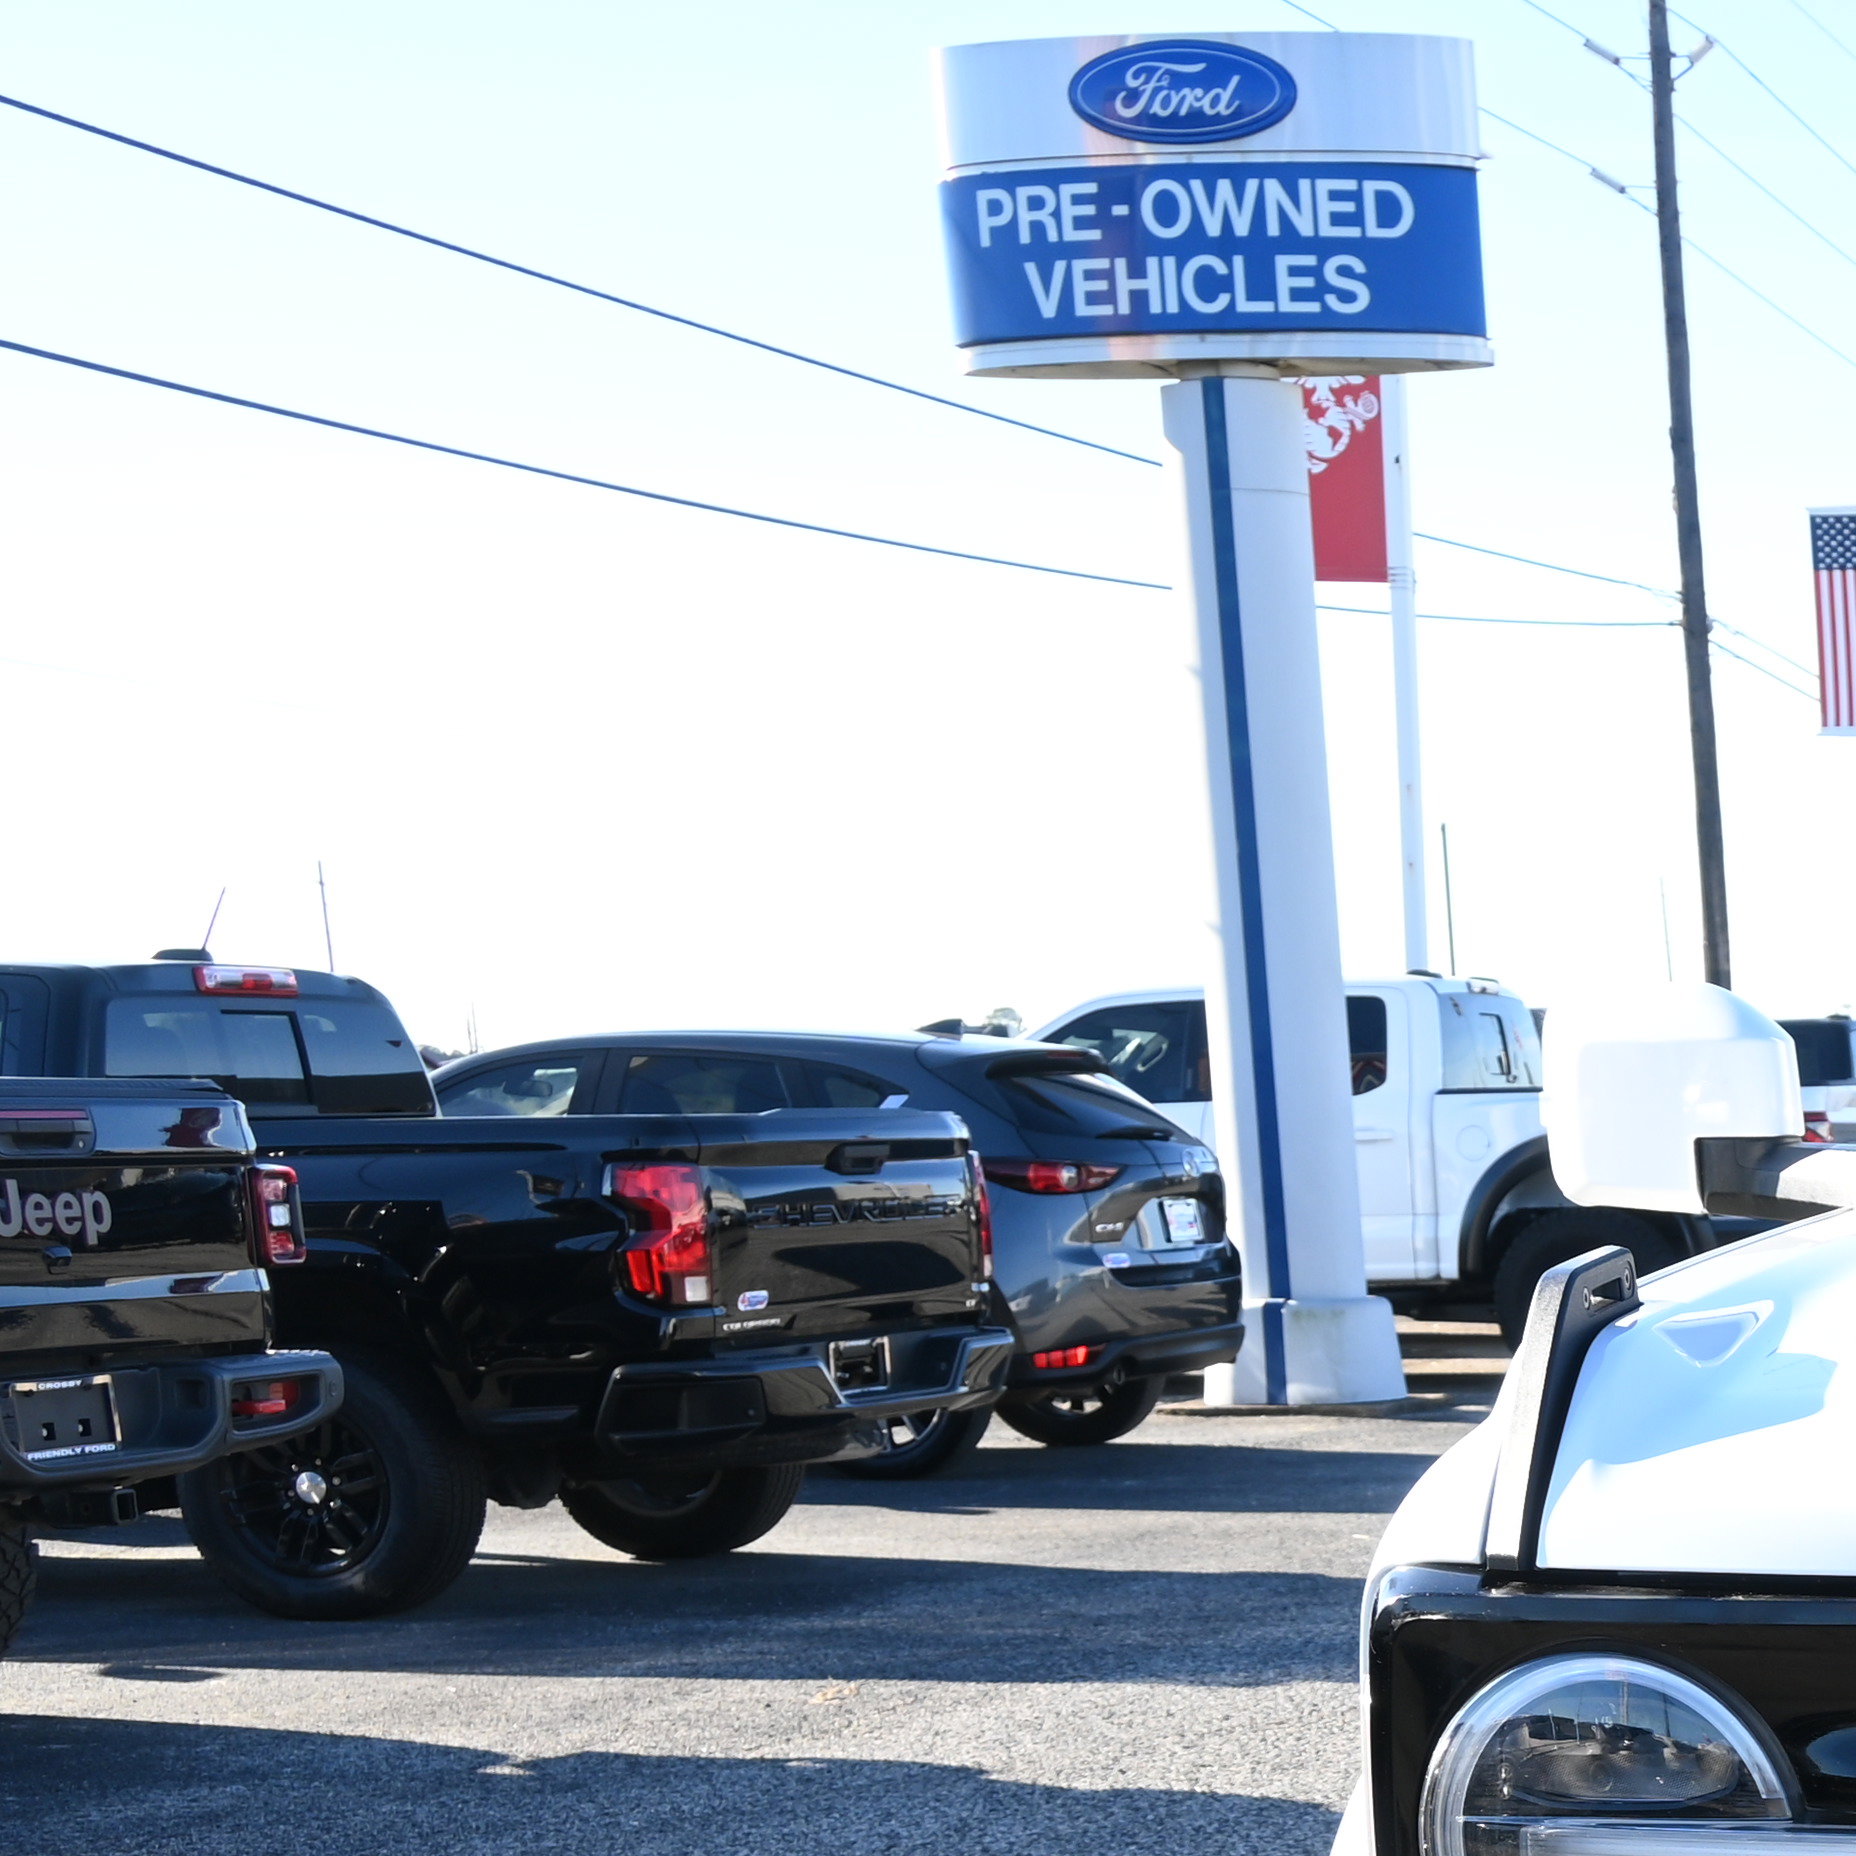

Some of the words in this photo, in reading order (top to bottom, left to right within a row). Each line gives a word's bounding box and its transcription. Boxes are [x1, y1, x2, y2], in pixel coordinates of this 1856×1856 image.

[1113, 61, 1241, 119] Ford
[975, 178, 1415, 248] PRE-OWNED
[1023, 254, 1372, 319] VEHICLES
[0, 1178, 113, 1246] Jeep
[38, 1380, 82, 1390] CROSBY
[27, 1447, 82, 1461] FRIENDLY
[84, 1443, 116, 1454] FORD
